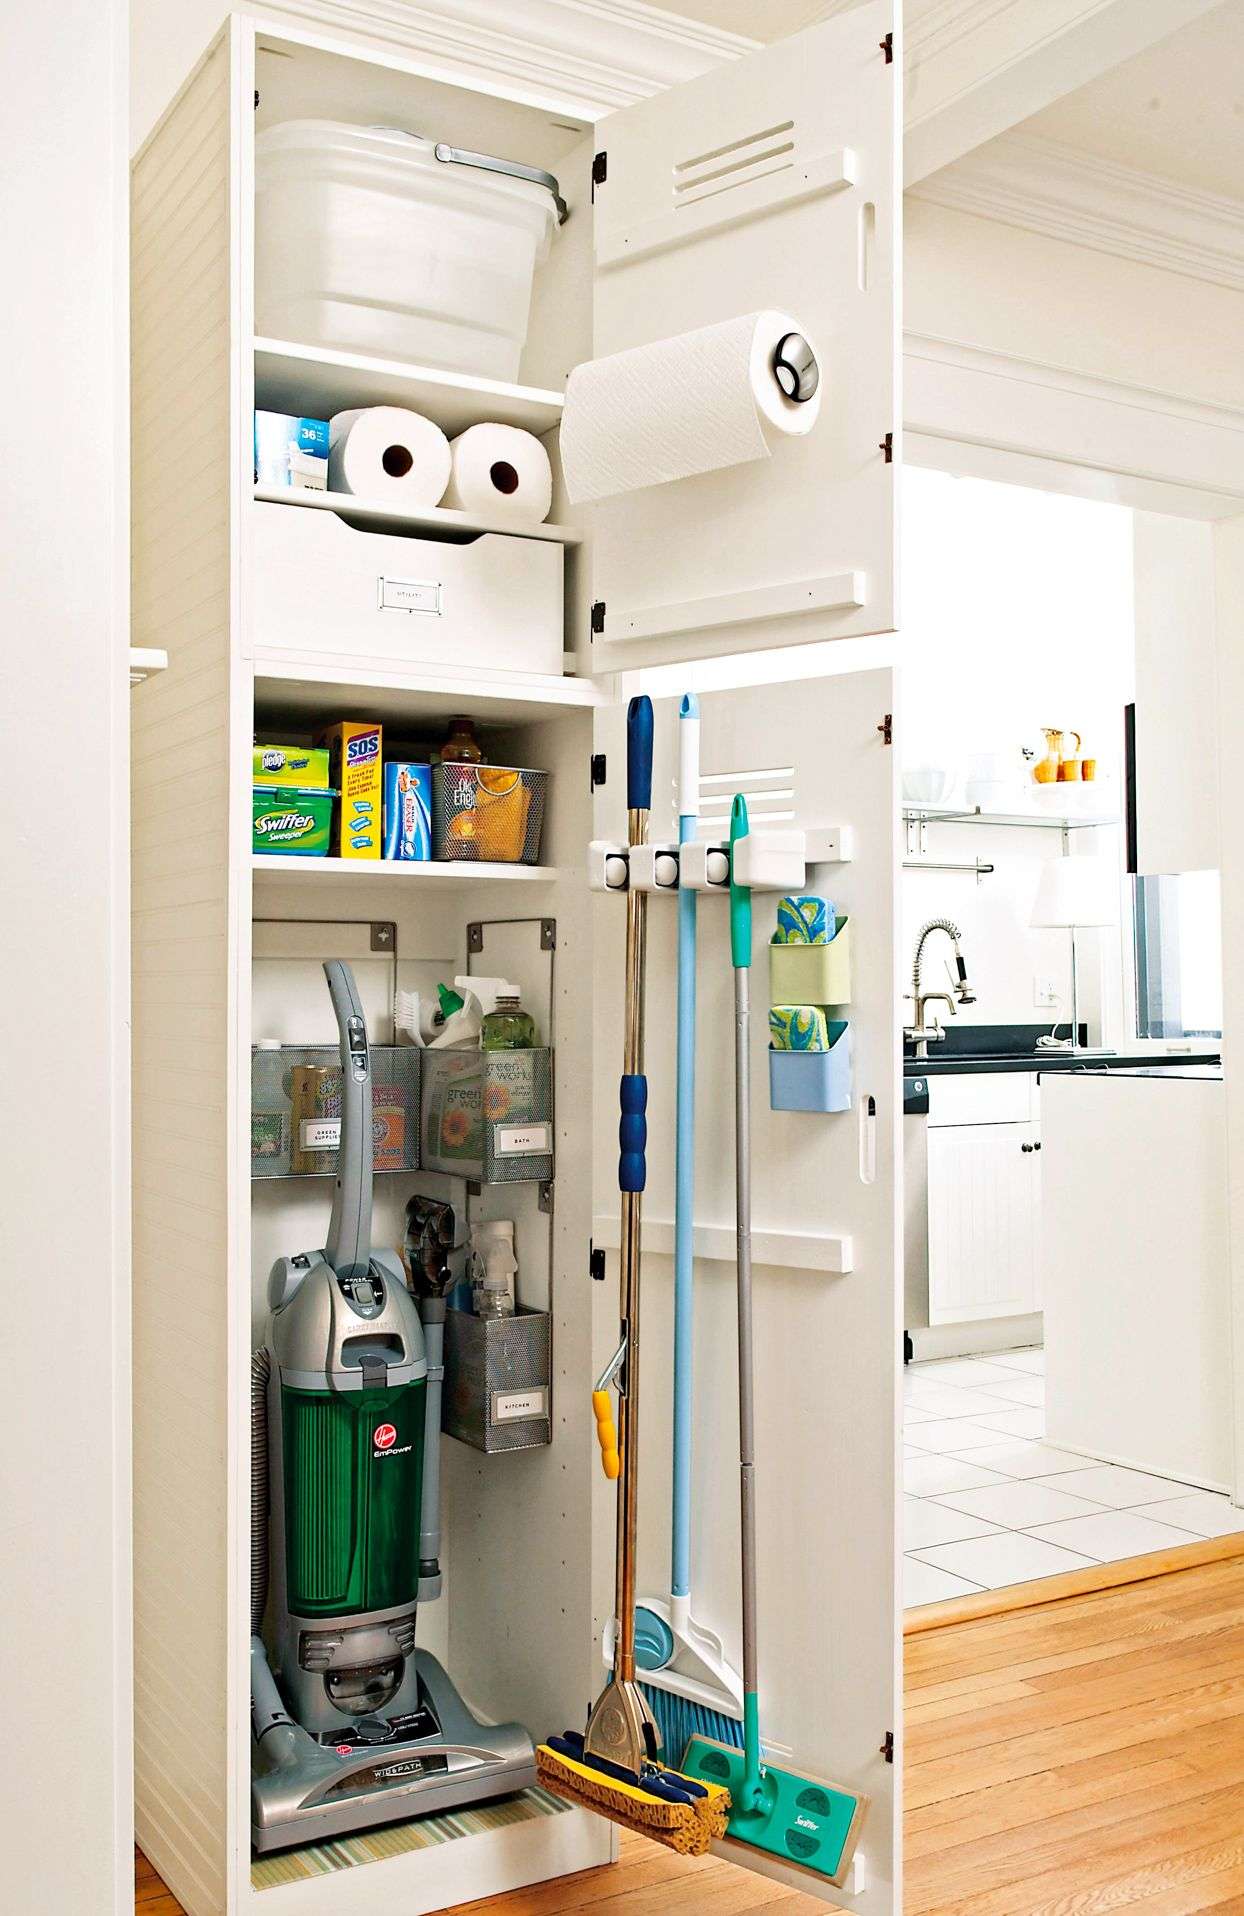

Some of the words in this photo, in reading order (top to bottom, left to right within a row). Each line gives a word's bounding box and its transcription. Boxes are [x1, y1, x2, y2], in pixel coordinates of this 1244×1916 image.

[302, 428, 316, 440] 36
[256, 814, 314, 834] Swiffer
[268, 831, 304, 842] Sweeper
[374, 1446, 412, 1458] EmPower
[795, 1815, 819, 1831] Swiffer
